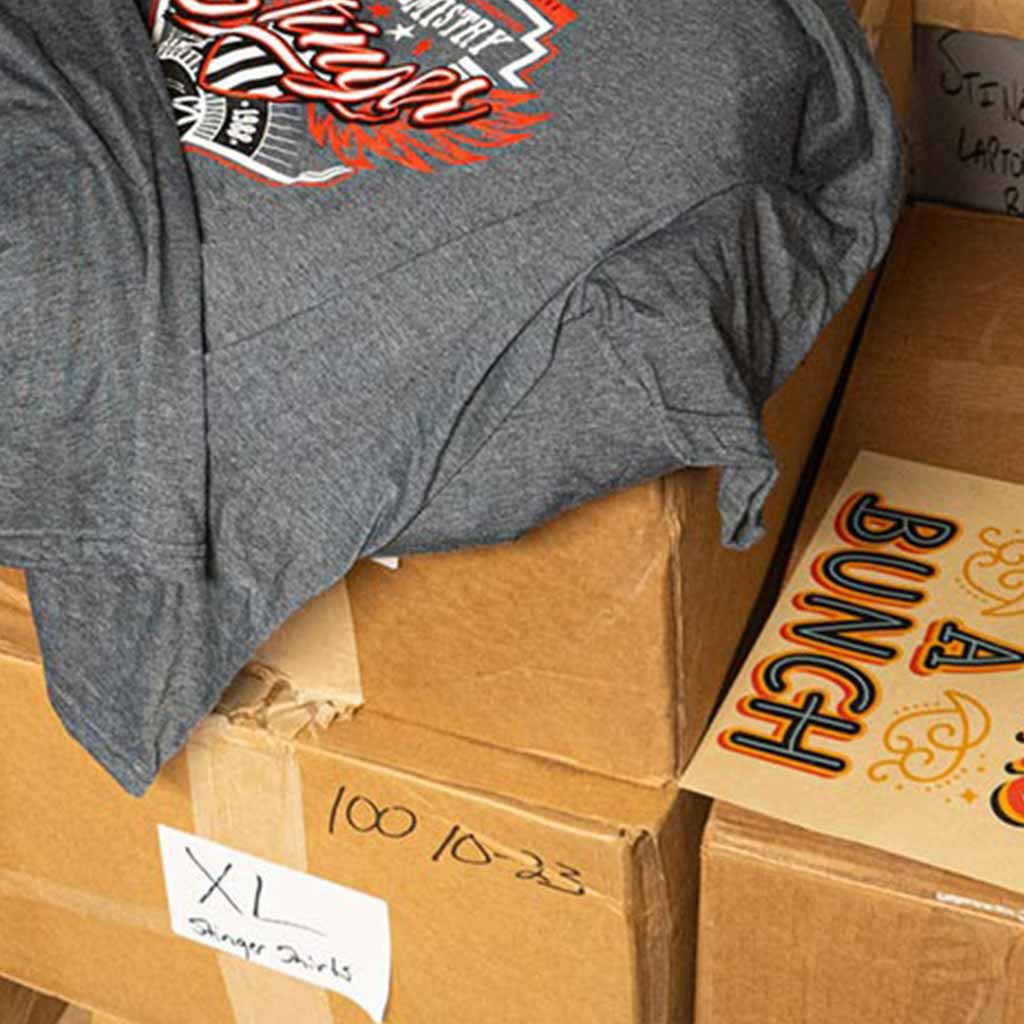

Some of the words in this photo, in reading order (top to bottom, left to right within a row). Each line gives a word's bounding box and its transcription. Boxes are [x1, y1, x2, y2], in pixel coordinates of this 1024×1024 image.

[718, 491, 962, 779] BUNCH
[910, 619, 1024, 676] A
[329, 786, 417, 839] 100
[431, 824, 586, 896] 10-23
[184, 846, 328, 937] XL
